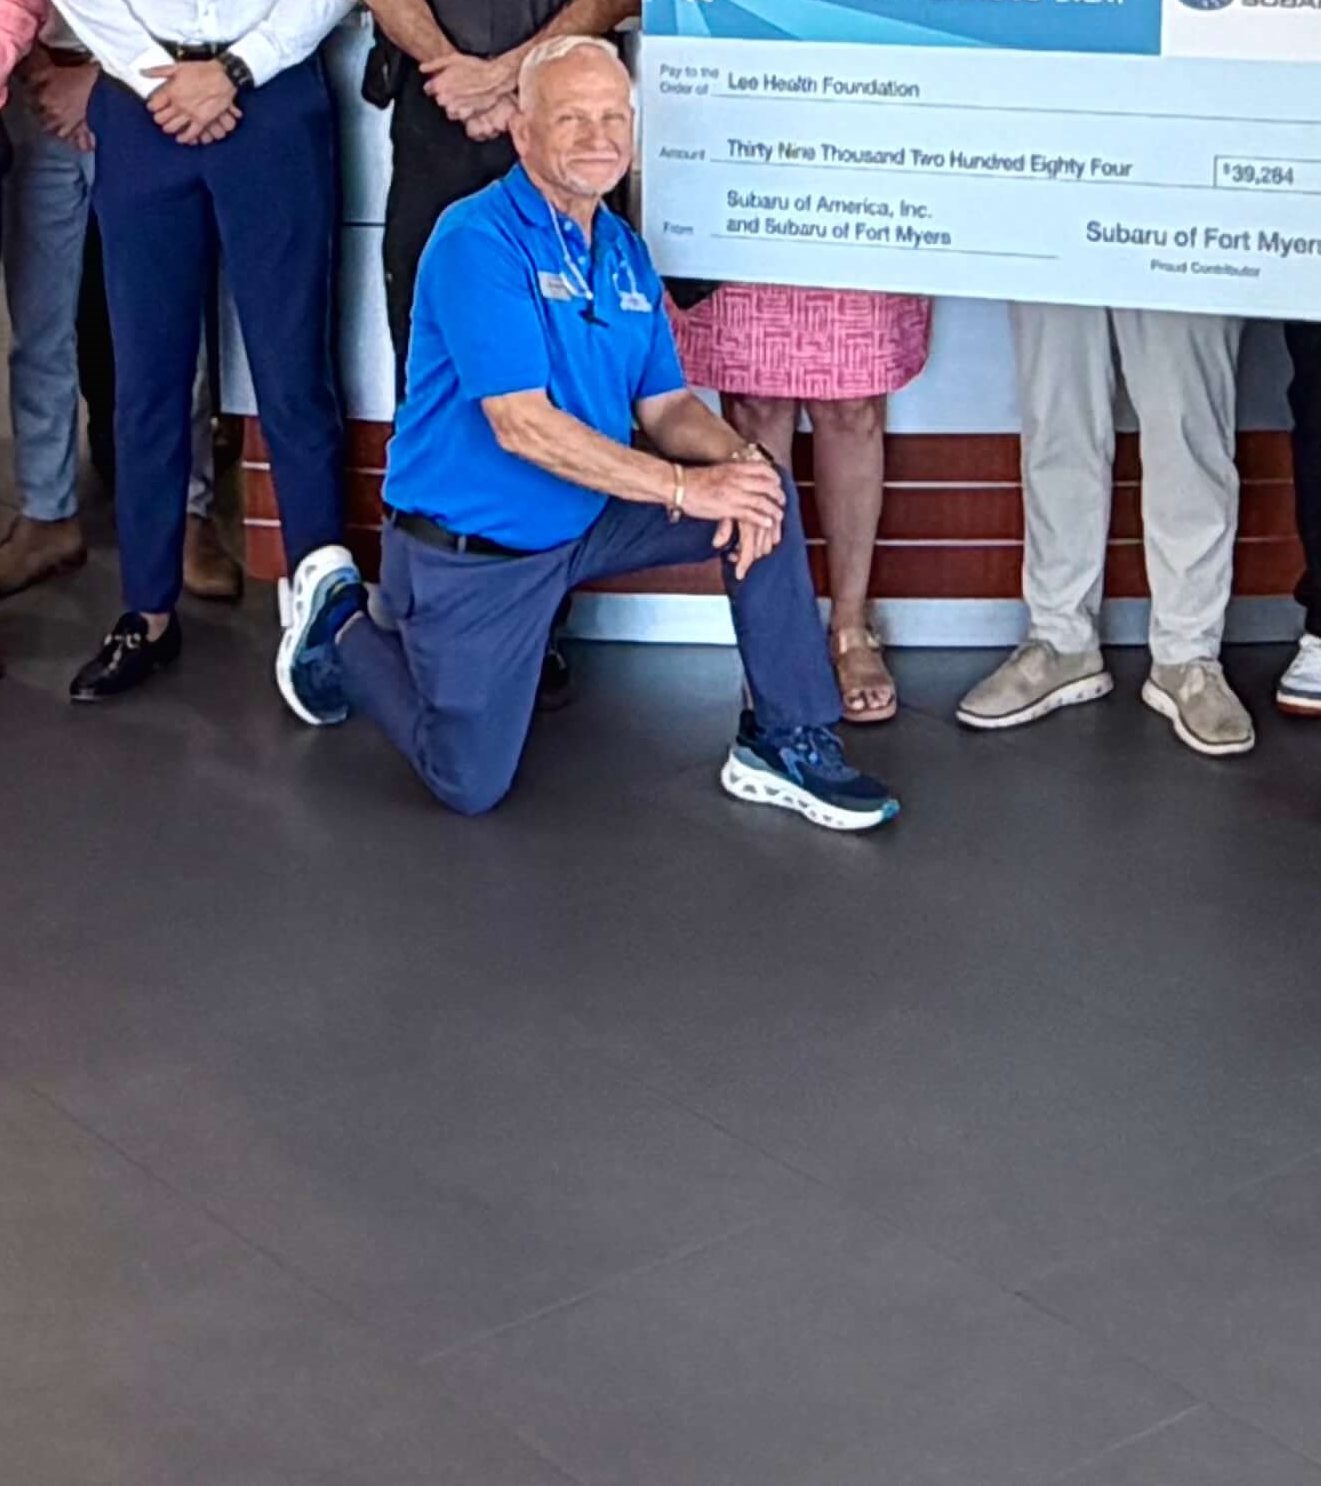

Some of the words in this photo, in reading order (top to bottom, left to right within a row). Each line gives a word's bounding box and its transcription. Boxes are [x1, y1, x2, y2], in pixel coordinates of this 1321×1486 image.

[659, 62, 683, 80] Pay
[684, 65, 699, 79] to
[699, 66, 720, 80] the
[658, 80, 694, 96] Order
[727, 71, 760, 91] Lee
[763, 73, 818, 94] Health
[822, 75, 921, 99] Foundation
[658, 145, 706, 161] Amount
[727, 138, 774, 162] Thirty
[777, 141, 816, 162] Nine
[820, 143, 906, 166] Thousand
[909, 148, 946, 168] Two
[949, 149, 1026, 172] Hundred
[1030, 153, 1086, 177] Eighty
[1090, 157, 1134, 177] Four
[1222, 162, 1295, 186] $39,284
[726, 189, 790, 211] Subaru
[793, 193, 813, 212] of
[815, 195, 895, 219] America,
[899, 199, 933, 219] Inc.
[662, 220, 695, 236] From
[725, 216, 761, 235] and
[764, 217, 827, 239] Subaru
[831, 221, 850, 239] of
[854, 221, 891, 243] Fort
[894, 225, 952, 246] Myers
[1086, 220, 1168, 247] Subaru
[1173, 226, 1198, 249] of
[1203, 226, 1251, 252] Fort
[1149, 257, 1188, 275] Proud
[1190, 260, 1262, 278] Contributor
